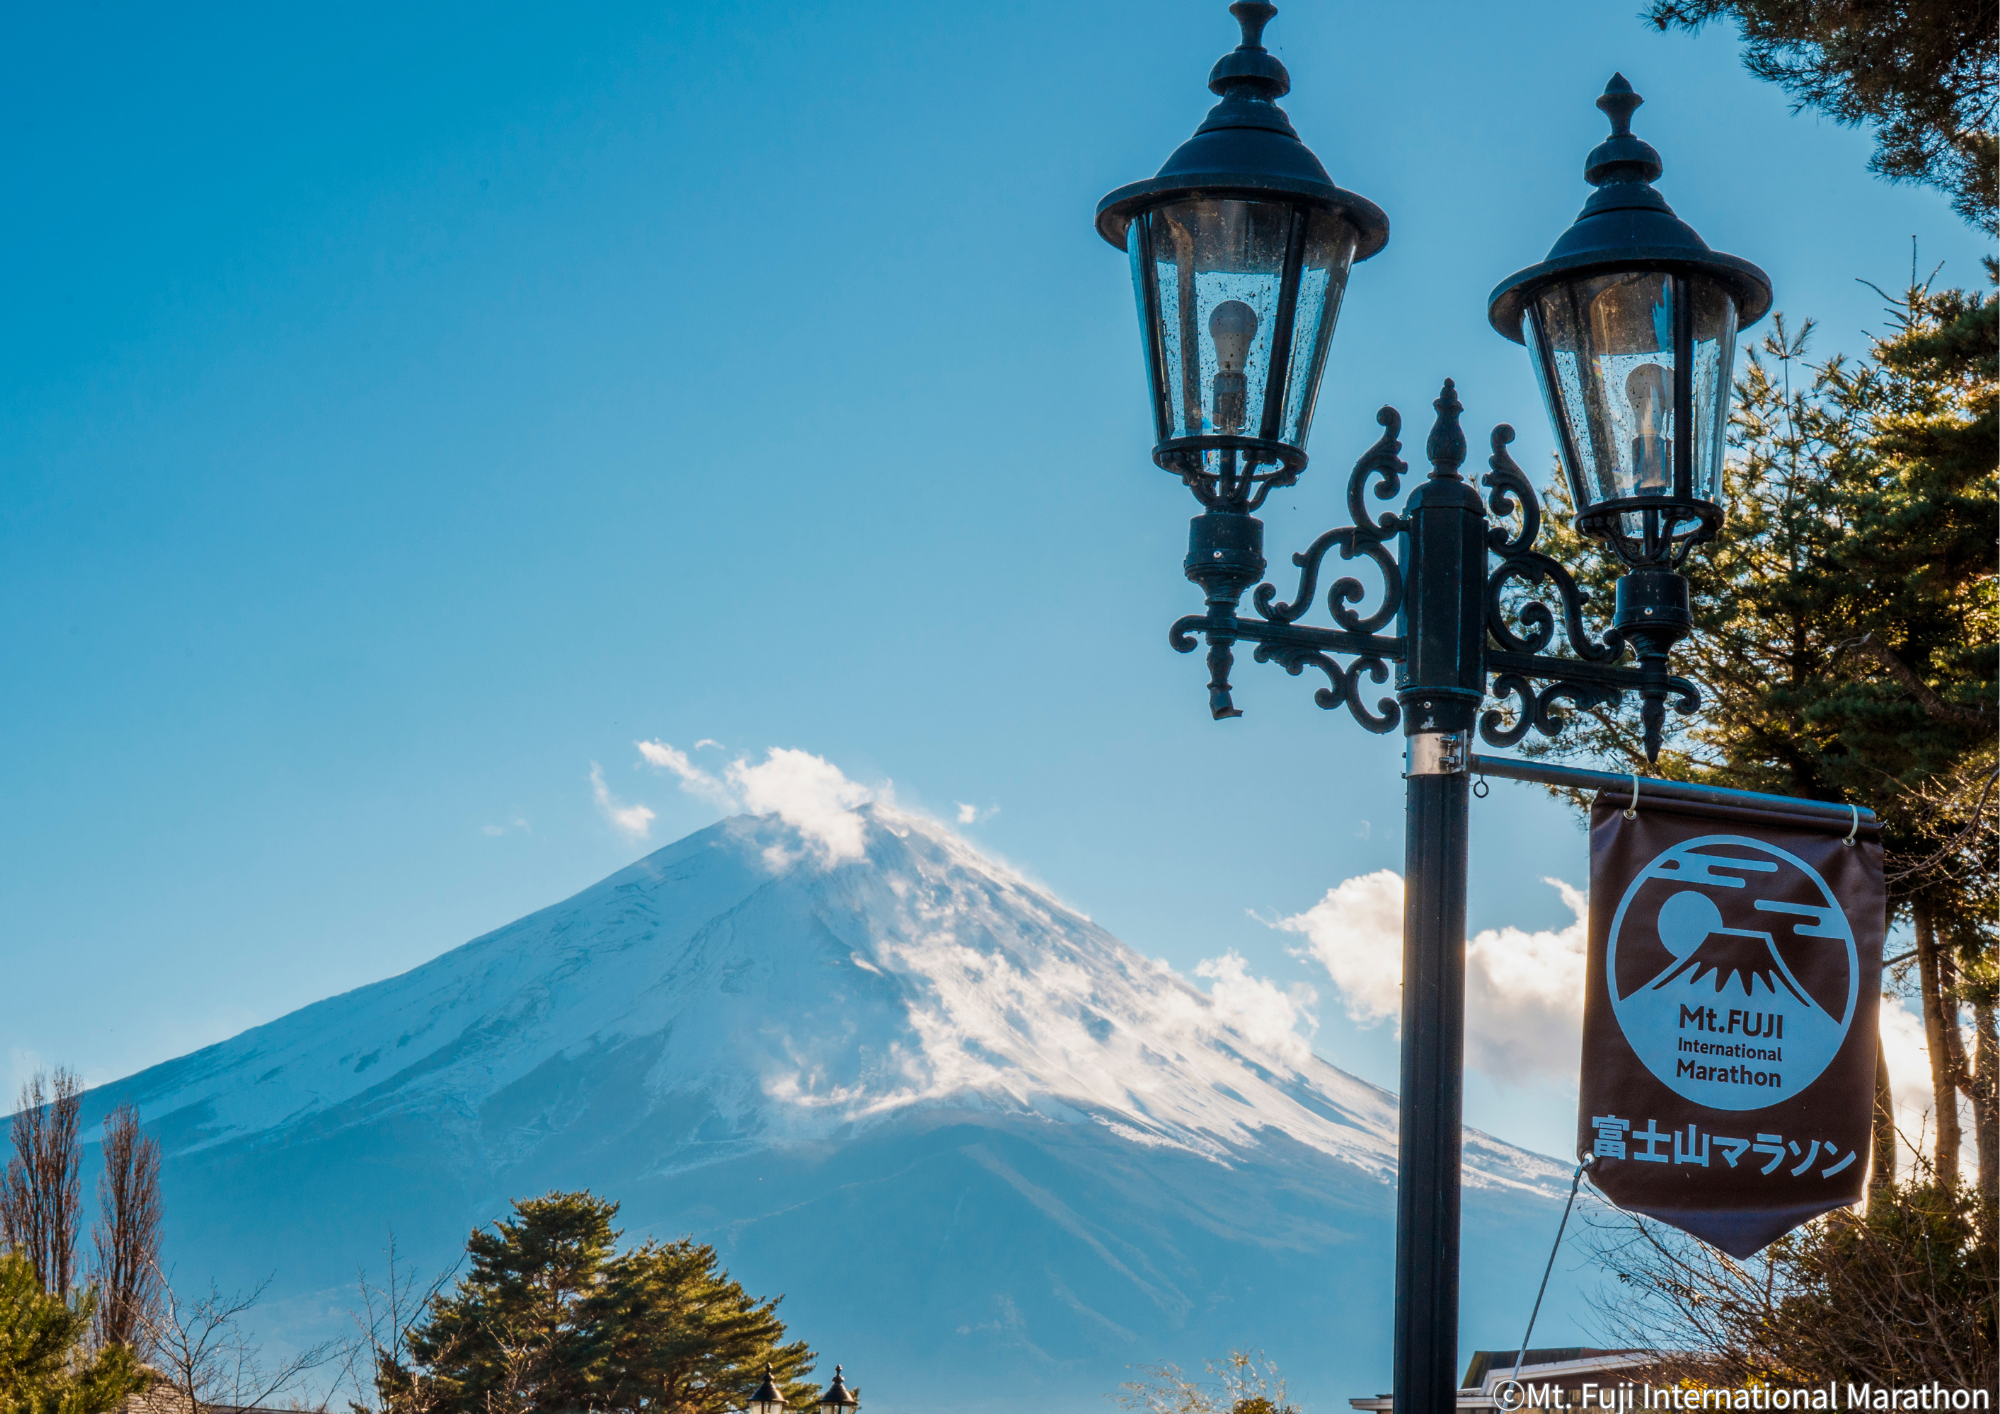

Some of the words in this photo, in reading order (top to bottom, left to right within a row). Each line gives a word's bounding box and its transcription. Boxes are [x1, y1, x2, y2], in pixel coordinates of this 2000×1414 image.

[1678, 1037, 1782, 1062] International
[1676, 1058, 1782, 1088] Marathon
[1591, 1114, 1857, 1179] 富士山マラソン
